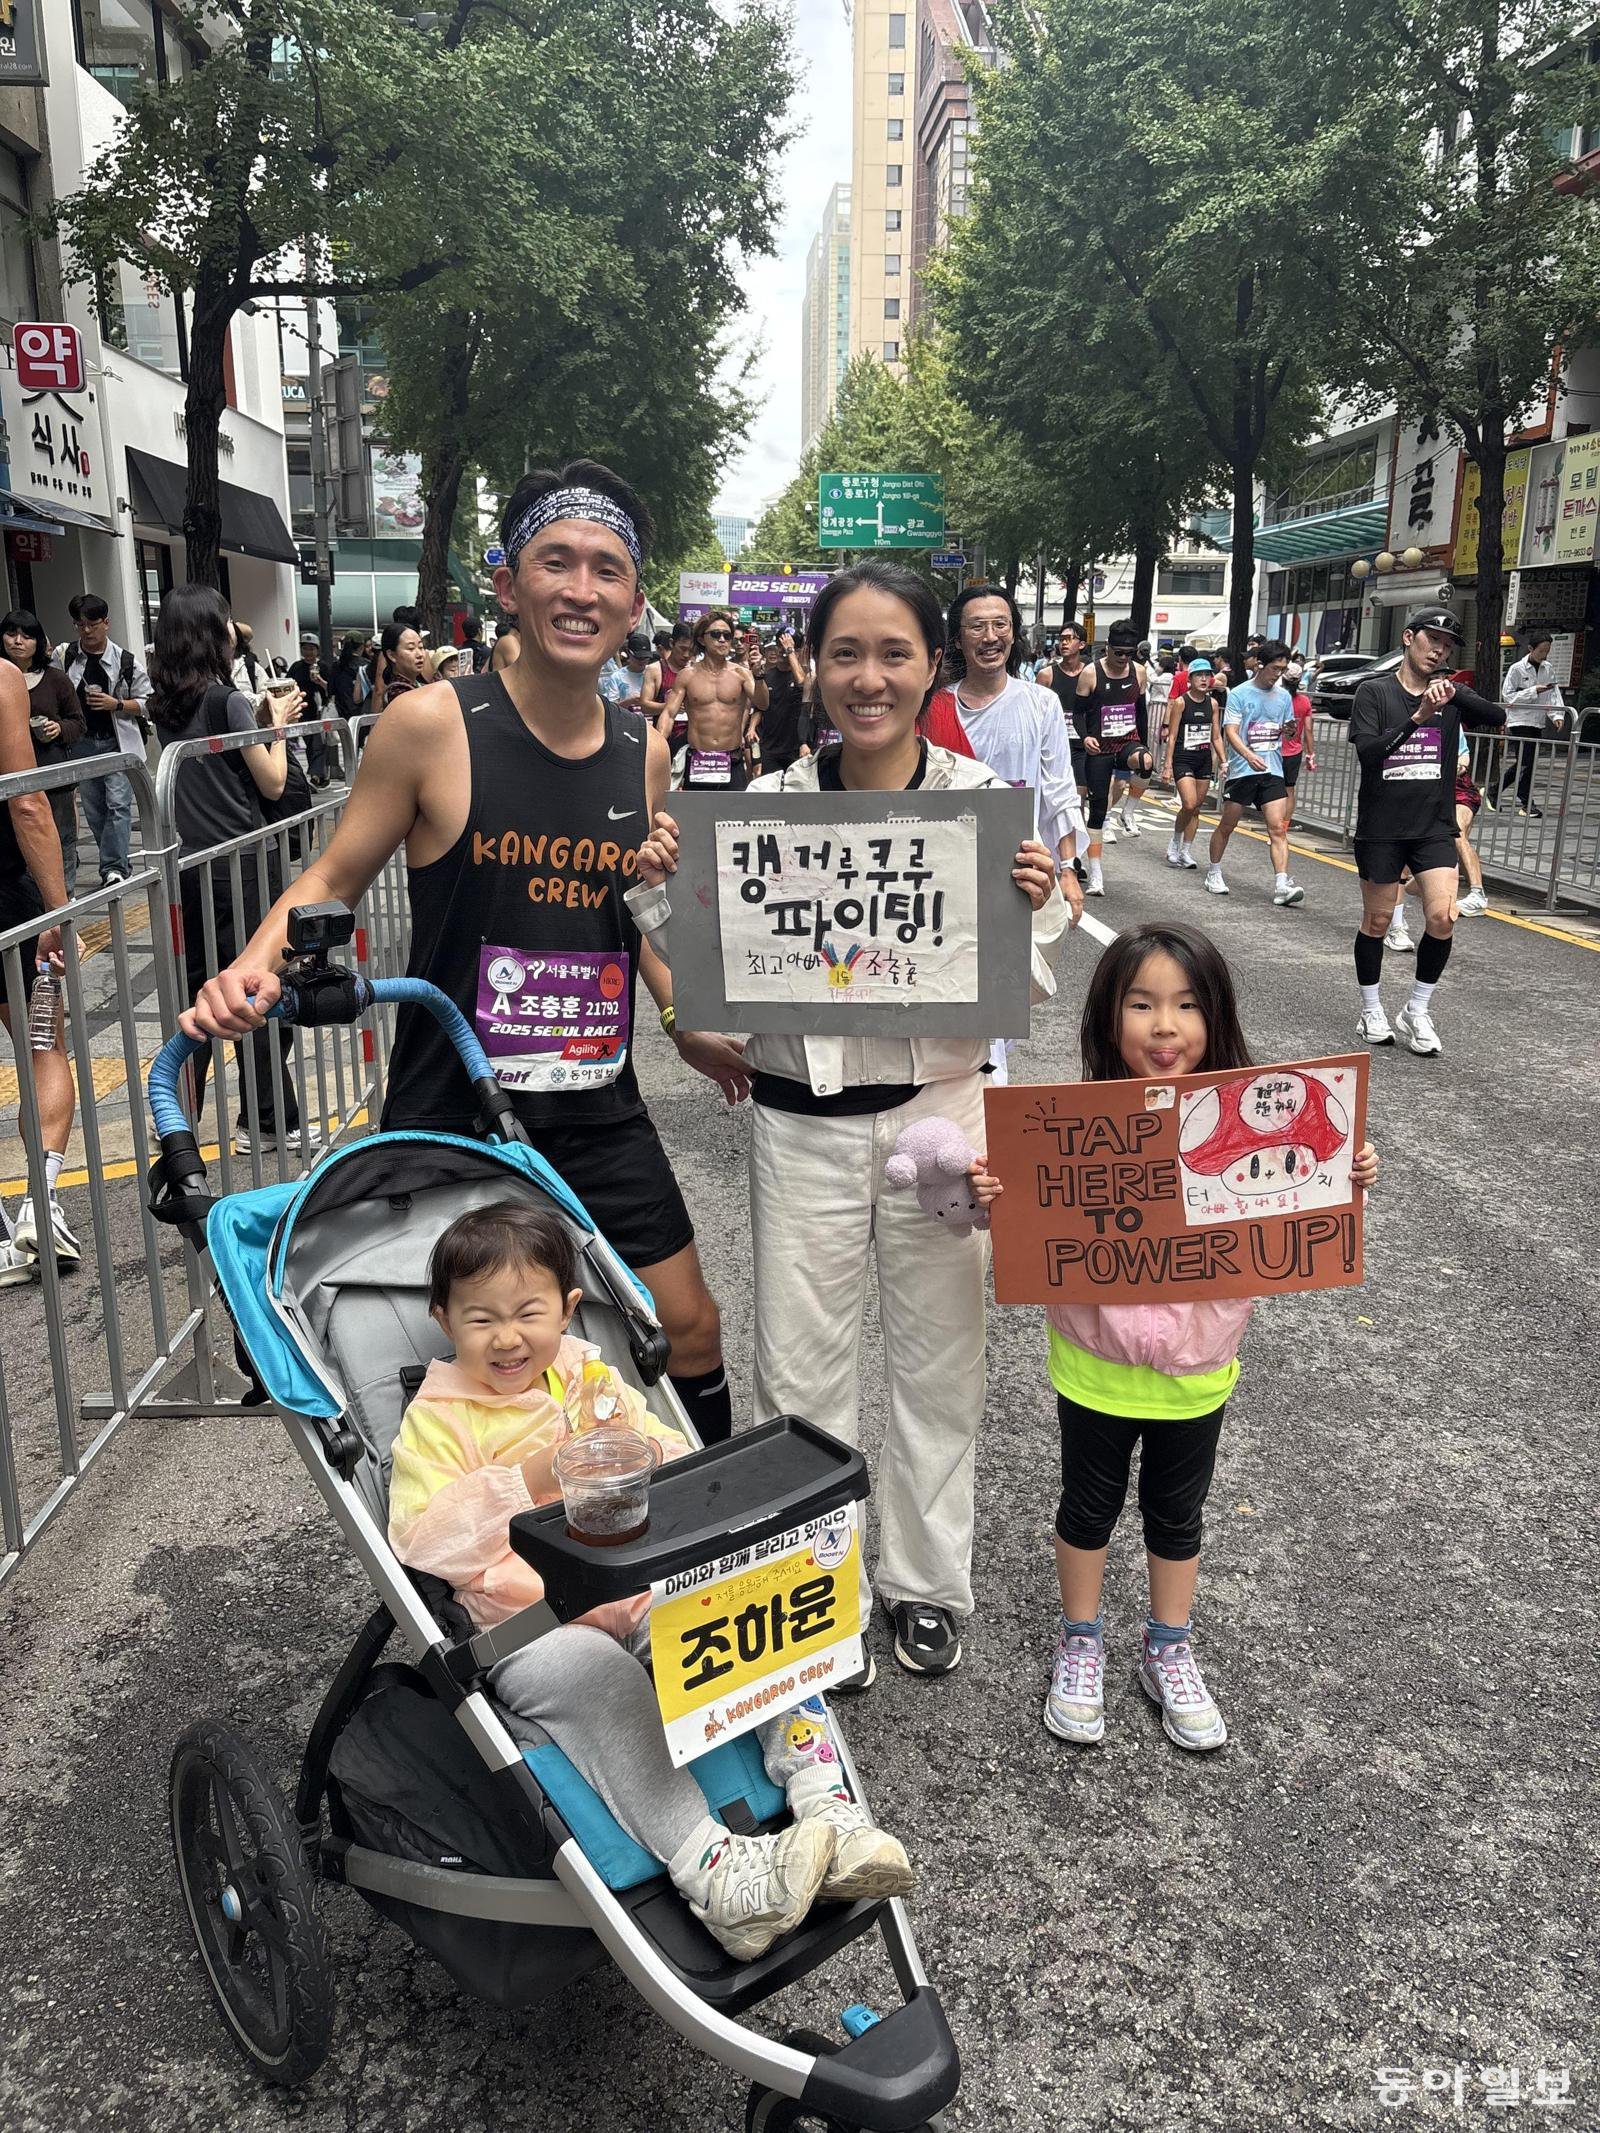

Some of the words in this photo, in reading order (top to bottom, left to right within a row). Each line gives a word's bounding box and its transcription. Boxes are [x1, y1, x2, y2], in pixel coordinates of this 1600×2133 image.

[20, 329, 72, 385] 약
[31, 412, 81, 475] 식사
[841, 476, 880, 488] 종로구청
[1570, 466, 1599, 491] 모밀
[844, 488, 879, 499] 종로1가
[1563, 496, 1597, 520] 돈까스
[821, 517, 854, 528] 청계광장
[907, 518, 925, 528] 광교
[907, 530, 942, 538] Gwanggyo
[1569, 525, 1587, 540] 전문
[731, 580, 769, 592] 2025
[769, 580, 818, 594] SEOUL
[473, 830, 644, 881] KANGARO
[528, 877, 609, 909] CREW
[764, 890, 945, 951] 파이팅!
[546, 964, 600, 979] 서울특별시
[491, 991, 512, 1016] A
[519, 995, 581, 1019] 조충훈
[585, 1001, 620, 1016] 21792
[489, 1022, 531, 1036] 2025
[531, 1025, 582, 1037] SEOUL
[583, 1025, 619, 1037] RACE
[568, 1044, 600, 1056] Agility
[570, 1067, 615, 1082] 동아일보
[1043, 1112, 1163, 1157] TAP
[1037, 1158, 1178, 1208] HERE
[1083, 1205, 1144, 1235] TO
[1045, 1229, 1242, 1287] POWER
[1250, 1213, 1355, 1281] UP!
[664, 1562, 716, 1597] 아이와
[718, 1549, 751, 1576] 함께
[754, 1530, 801, 1562] 달리고
[680, 1574, 837, 1692] 조하윤
[725, 1676, 796, 1724] KANGAROO
[798, 1656, 836, 1686] CREW
